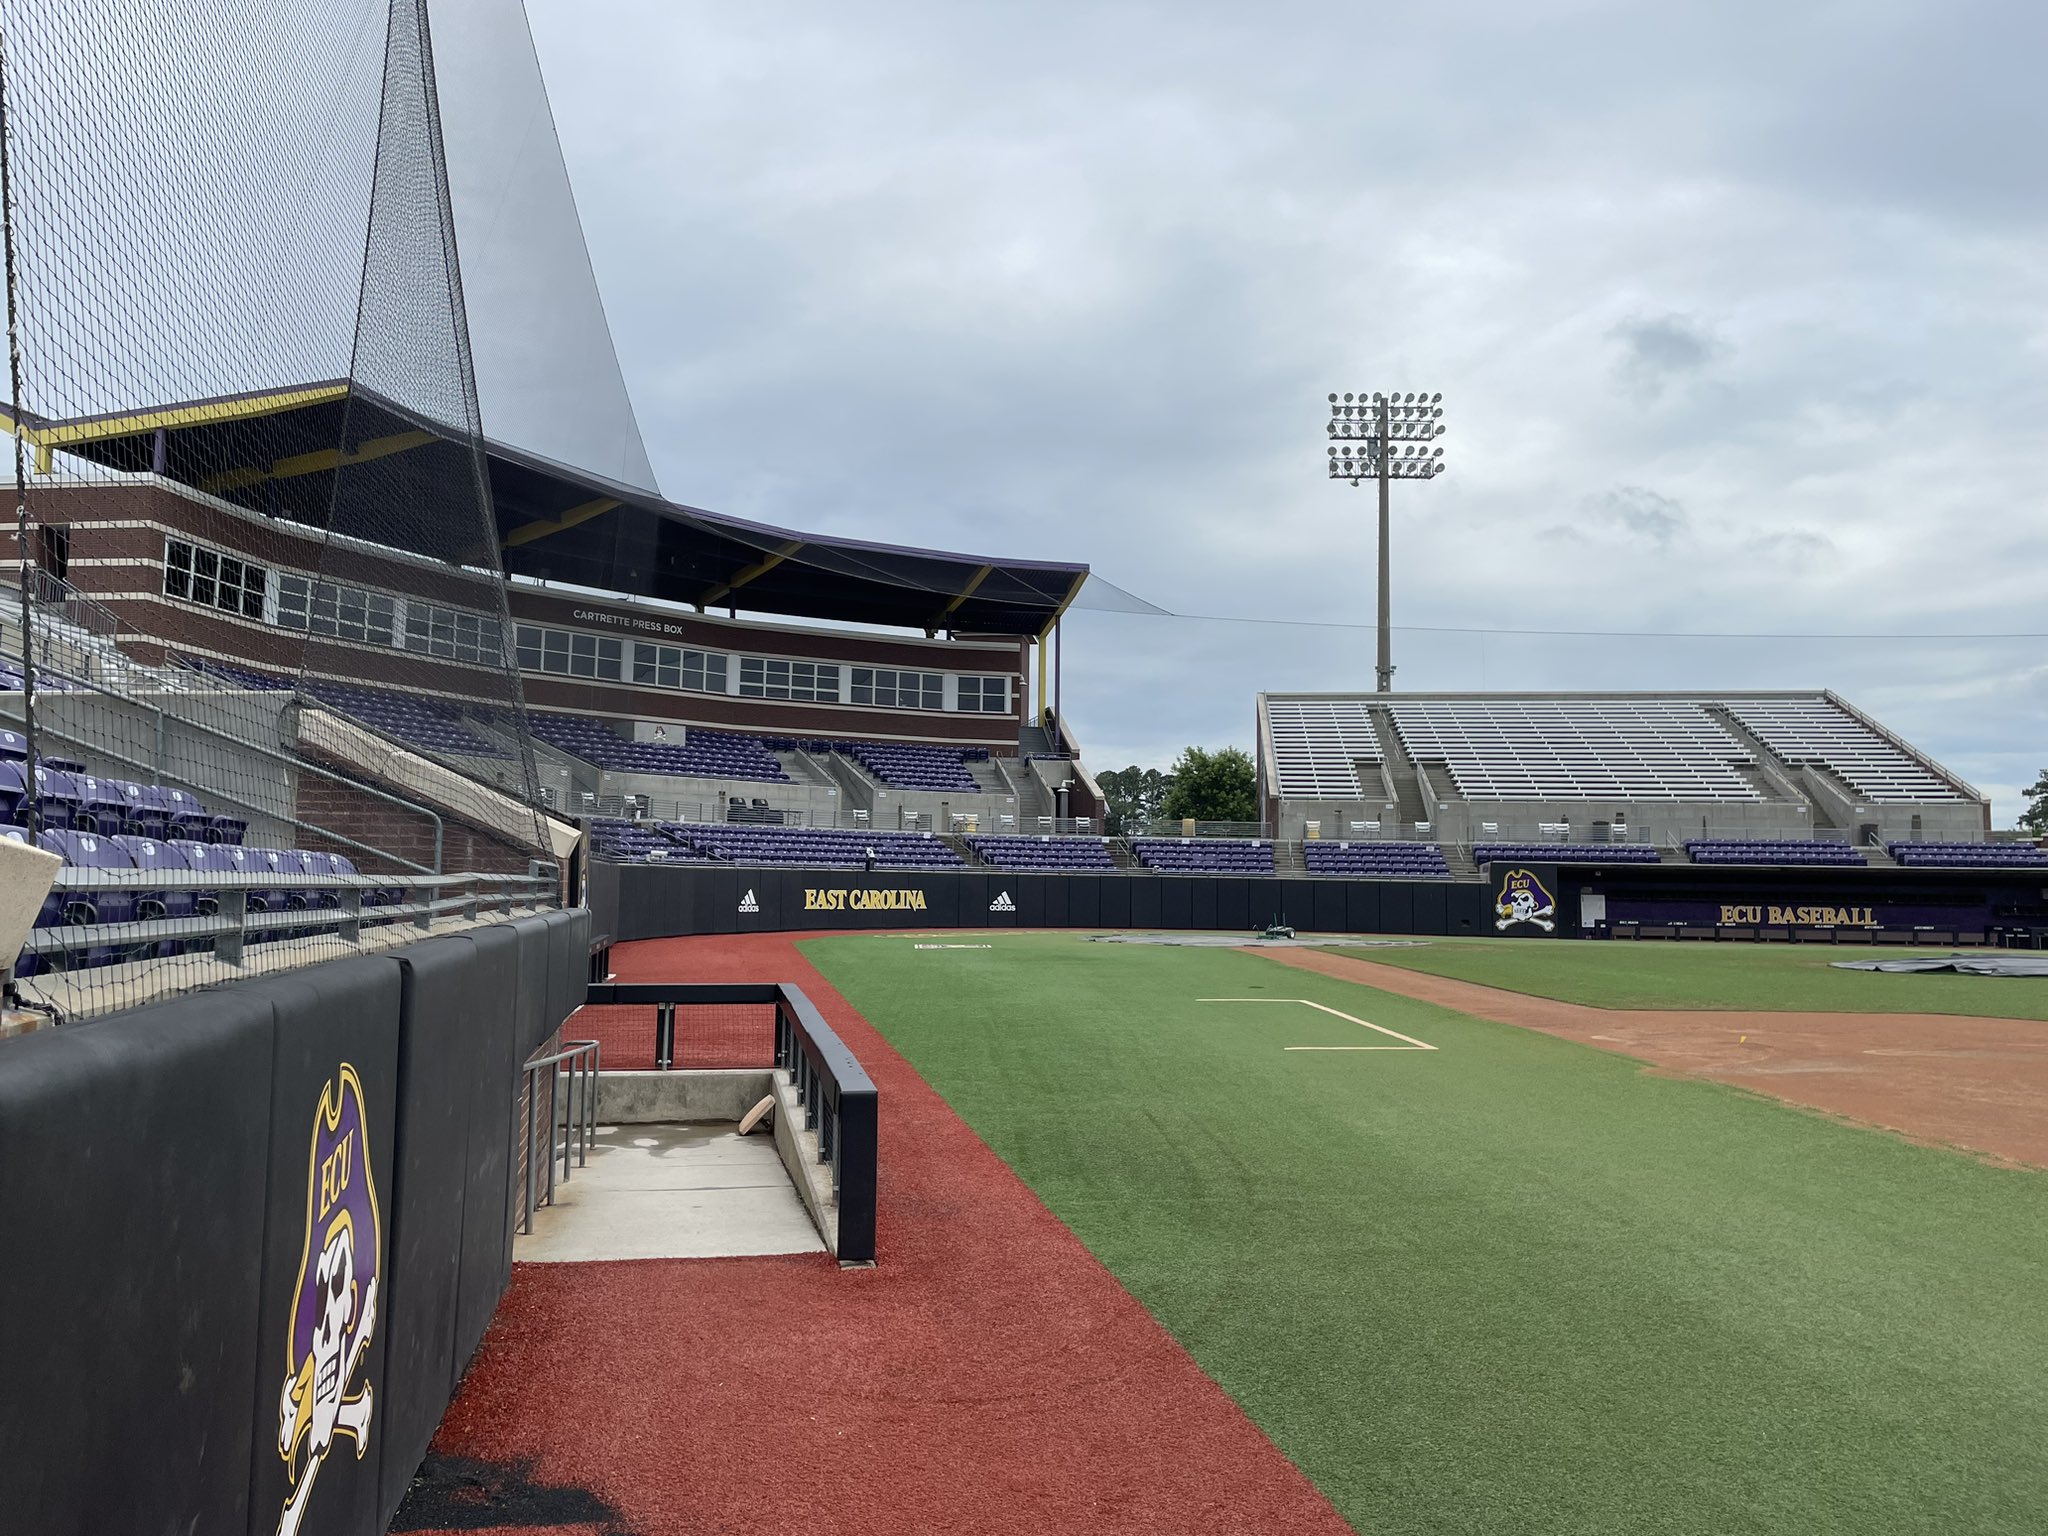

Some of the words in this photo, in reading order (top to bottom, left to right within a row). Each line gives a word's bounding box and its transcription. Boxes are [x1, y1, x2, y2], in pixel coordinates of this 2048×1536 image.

[573, 609, 630, 627] CARTRETTE
[632, 618, 662, 632] PRESS
[664, 623, 683, 635] BOX
[1511, 879, 1530, 889] ECU
[738, 904, 760, 912] adidas
[804, 889, 847, 910] EAST
[849, 889, 928, 912] CAROLINA
[989, 903, 1016, 911] adidas
[1720, 906, 1762, 924] ECU
[1768, 906, 1878, 925] BASEBALL
[318, 1127, 355, 1223] ECU
